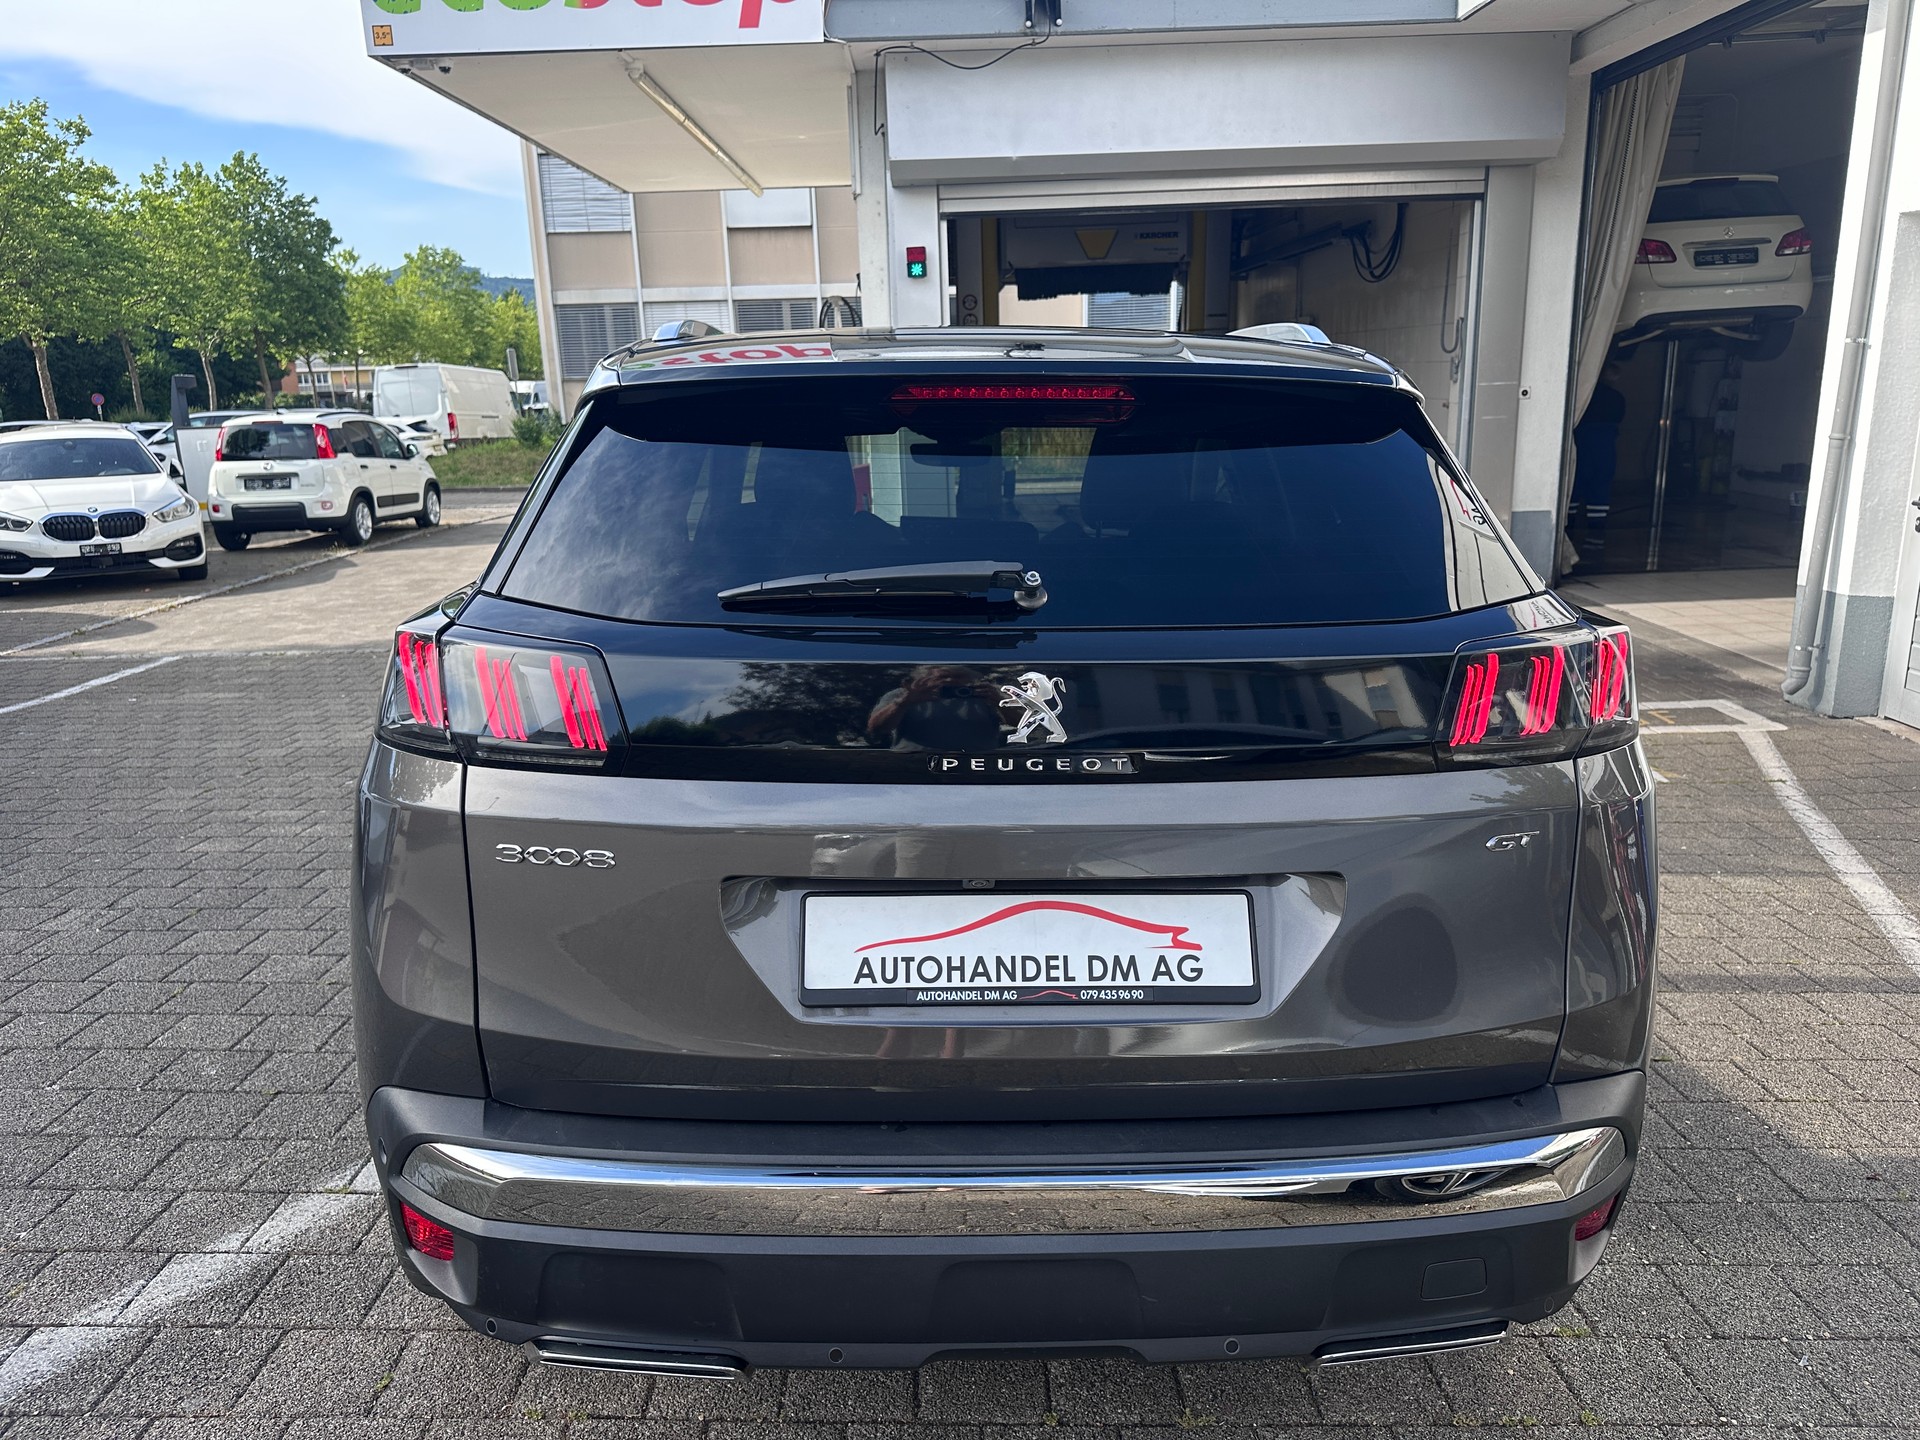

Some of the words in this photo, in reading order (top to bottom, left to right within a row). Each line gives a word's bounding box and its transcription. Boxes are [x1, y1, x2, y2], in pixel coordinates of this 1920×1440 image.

[942, 757, 1129, 771] PEUGEOT
[1485, 830, 1540, 852] GT
[495, 843, 617, 869] 3008
[853, 955, 1076, 985] AUTOHANDEL
[1087, 954, 1141, 982] DM
[1151, 954, 1204, 983] AG
[916, 990, 983, 1001] AUTOHANDEL
[984, 990, 1001, 1001] DM
[1002, 990, 1018, 1001] AG
